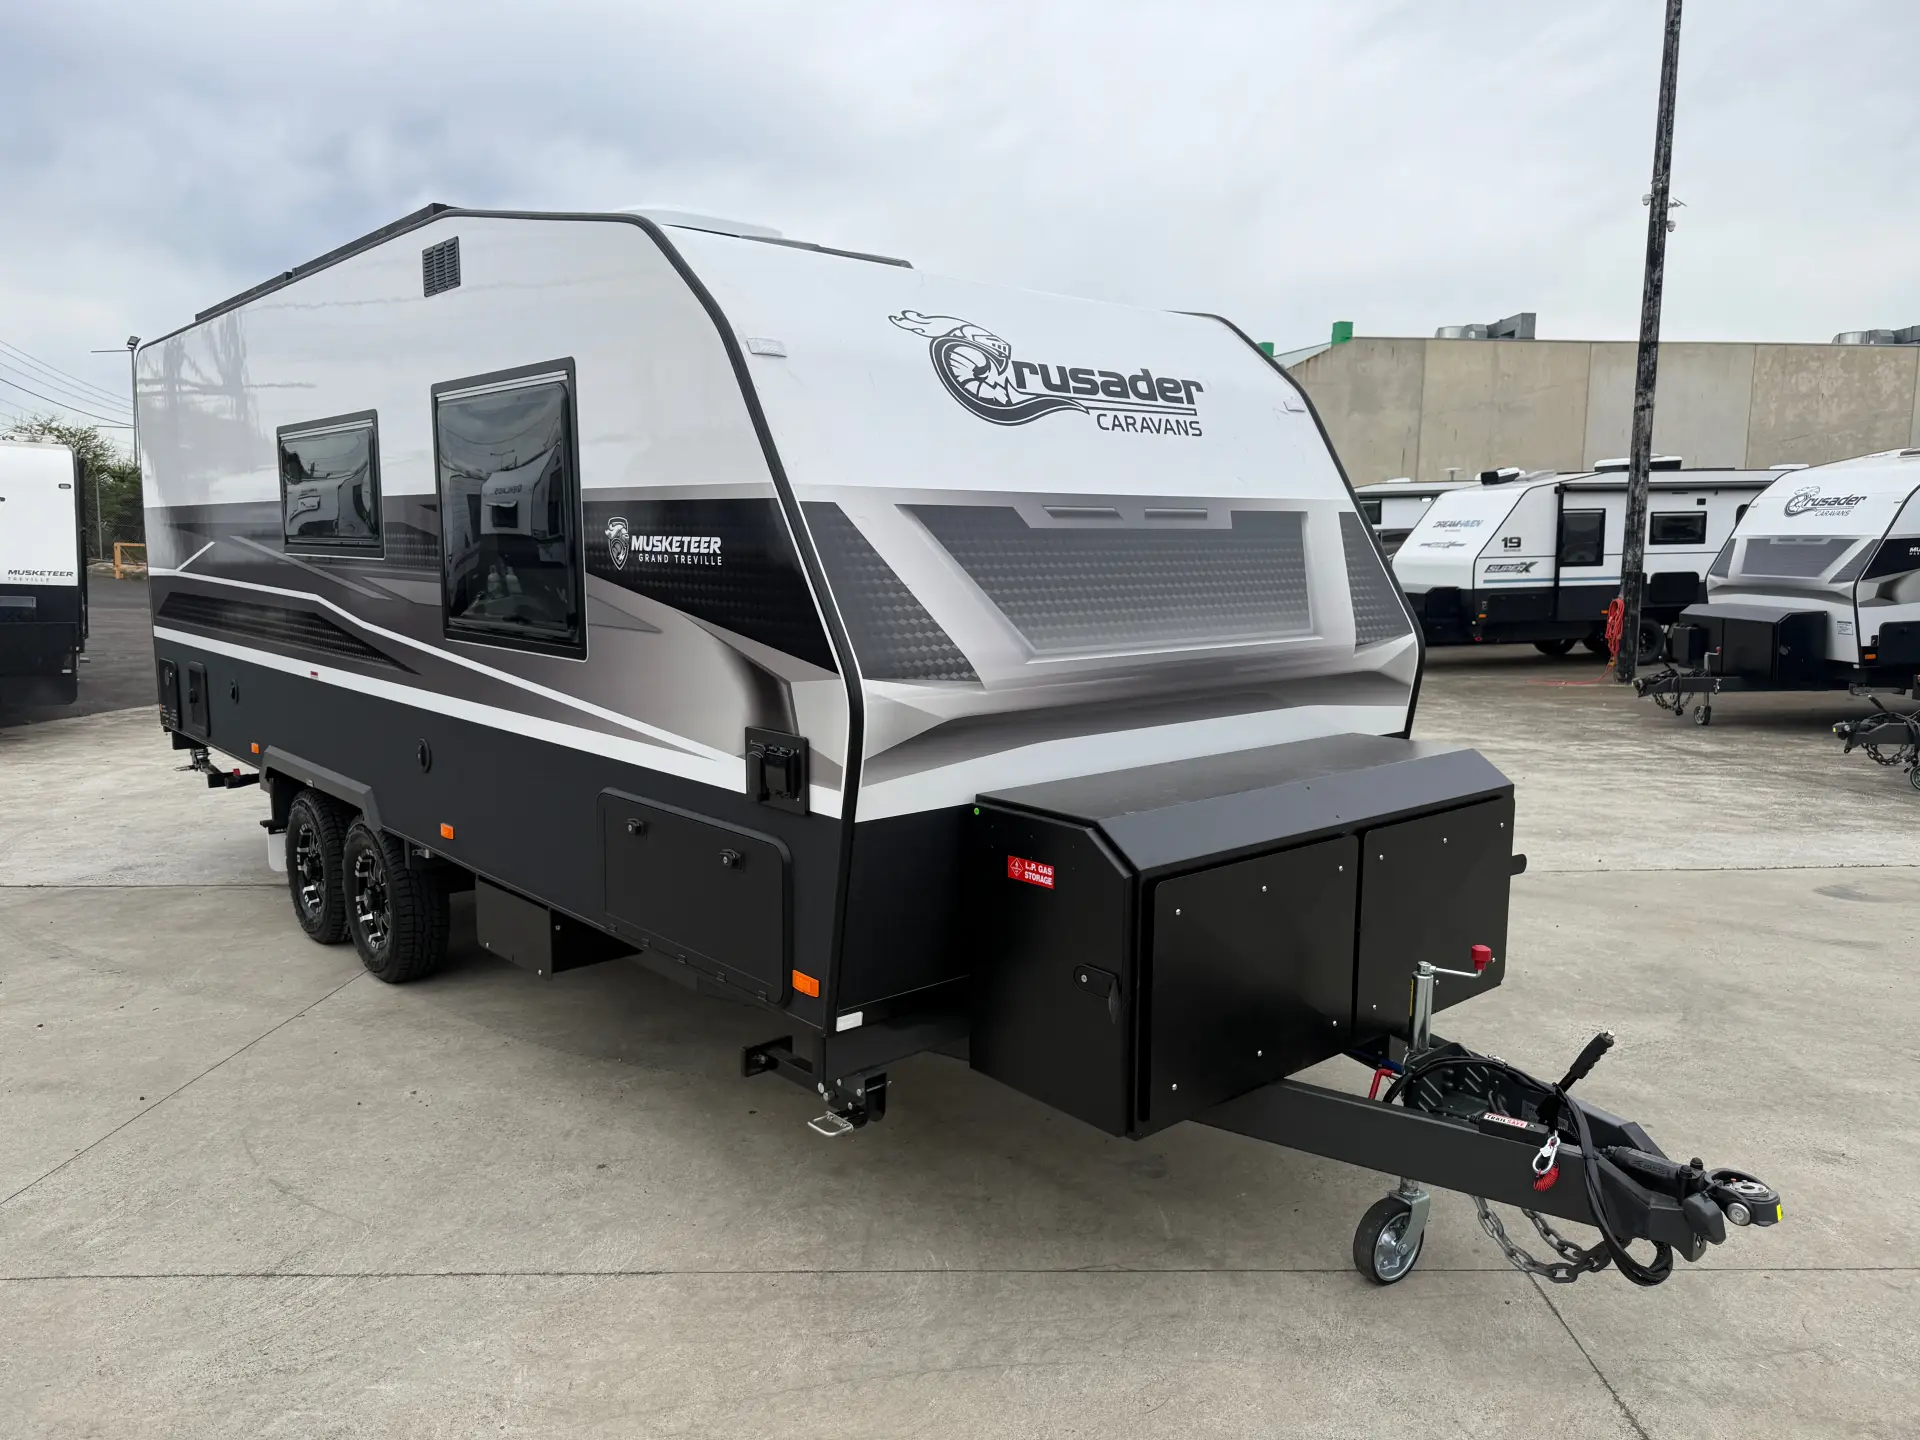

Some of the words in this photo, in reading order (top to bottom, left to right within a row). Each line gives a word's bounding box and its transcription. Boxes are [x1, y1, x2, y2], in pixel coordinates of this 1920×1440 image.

[1096, 413, 1203, 437] CARAVANS
[631, 535, 722, 554] MUSKETEER
[1501, 536, 1522, 549] 19
[638, 553, 669, 563] GRAND
[674, 554, 722, 566] TREVILLE
[8, 569, 74, 577] MUSKETEER
[1038, 865, 1052, 875] GAS
[1024, 871, 1053, 885] STORAGE
